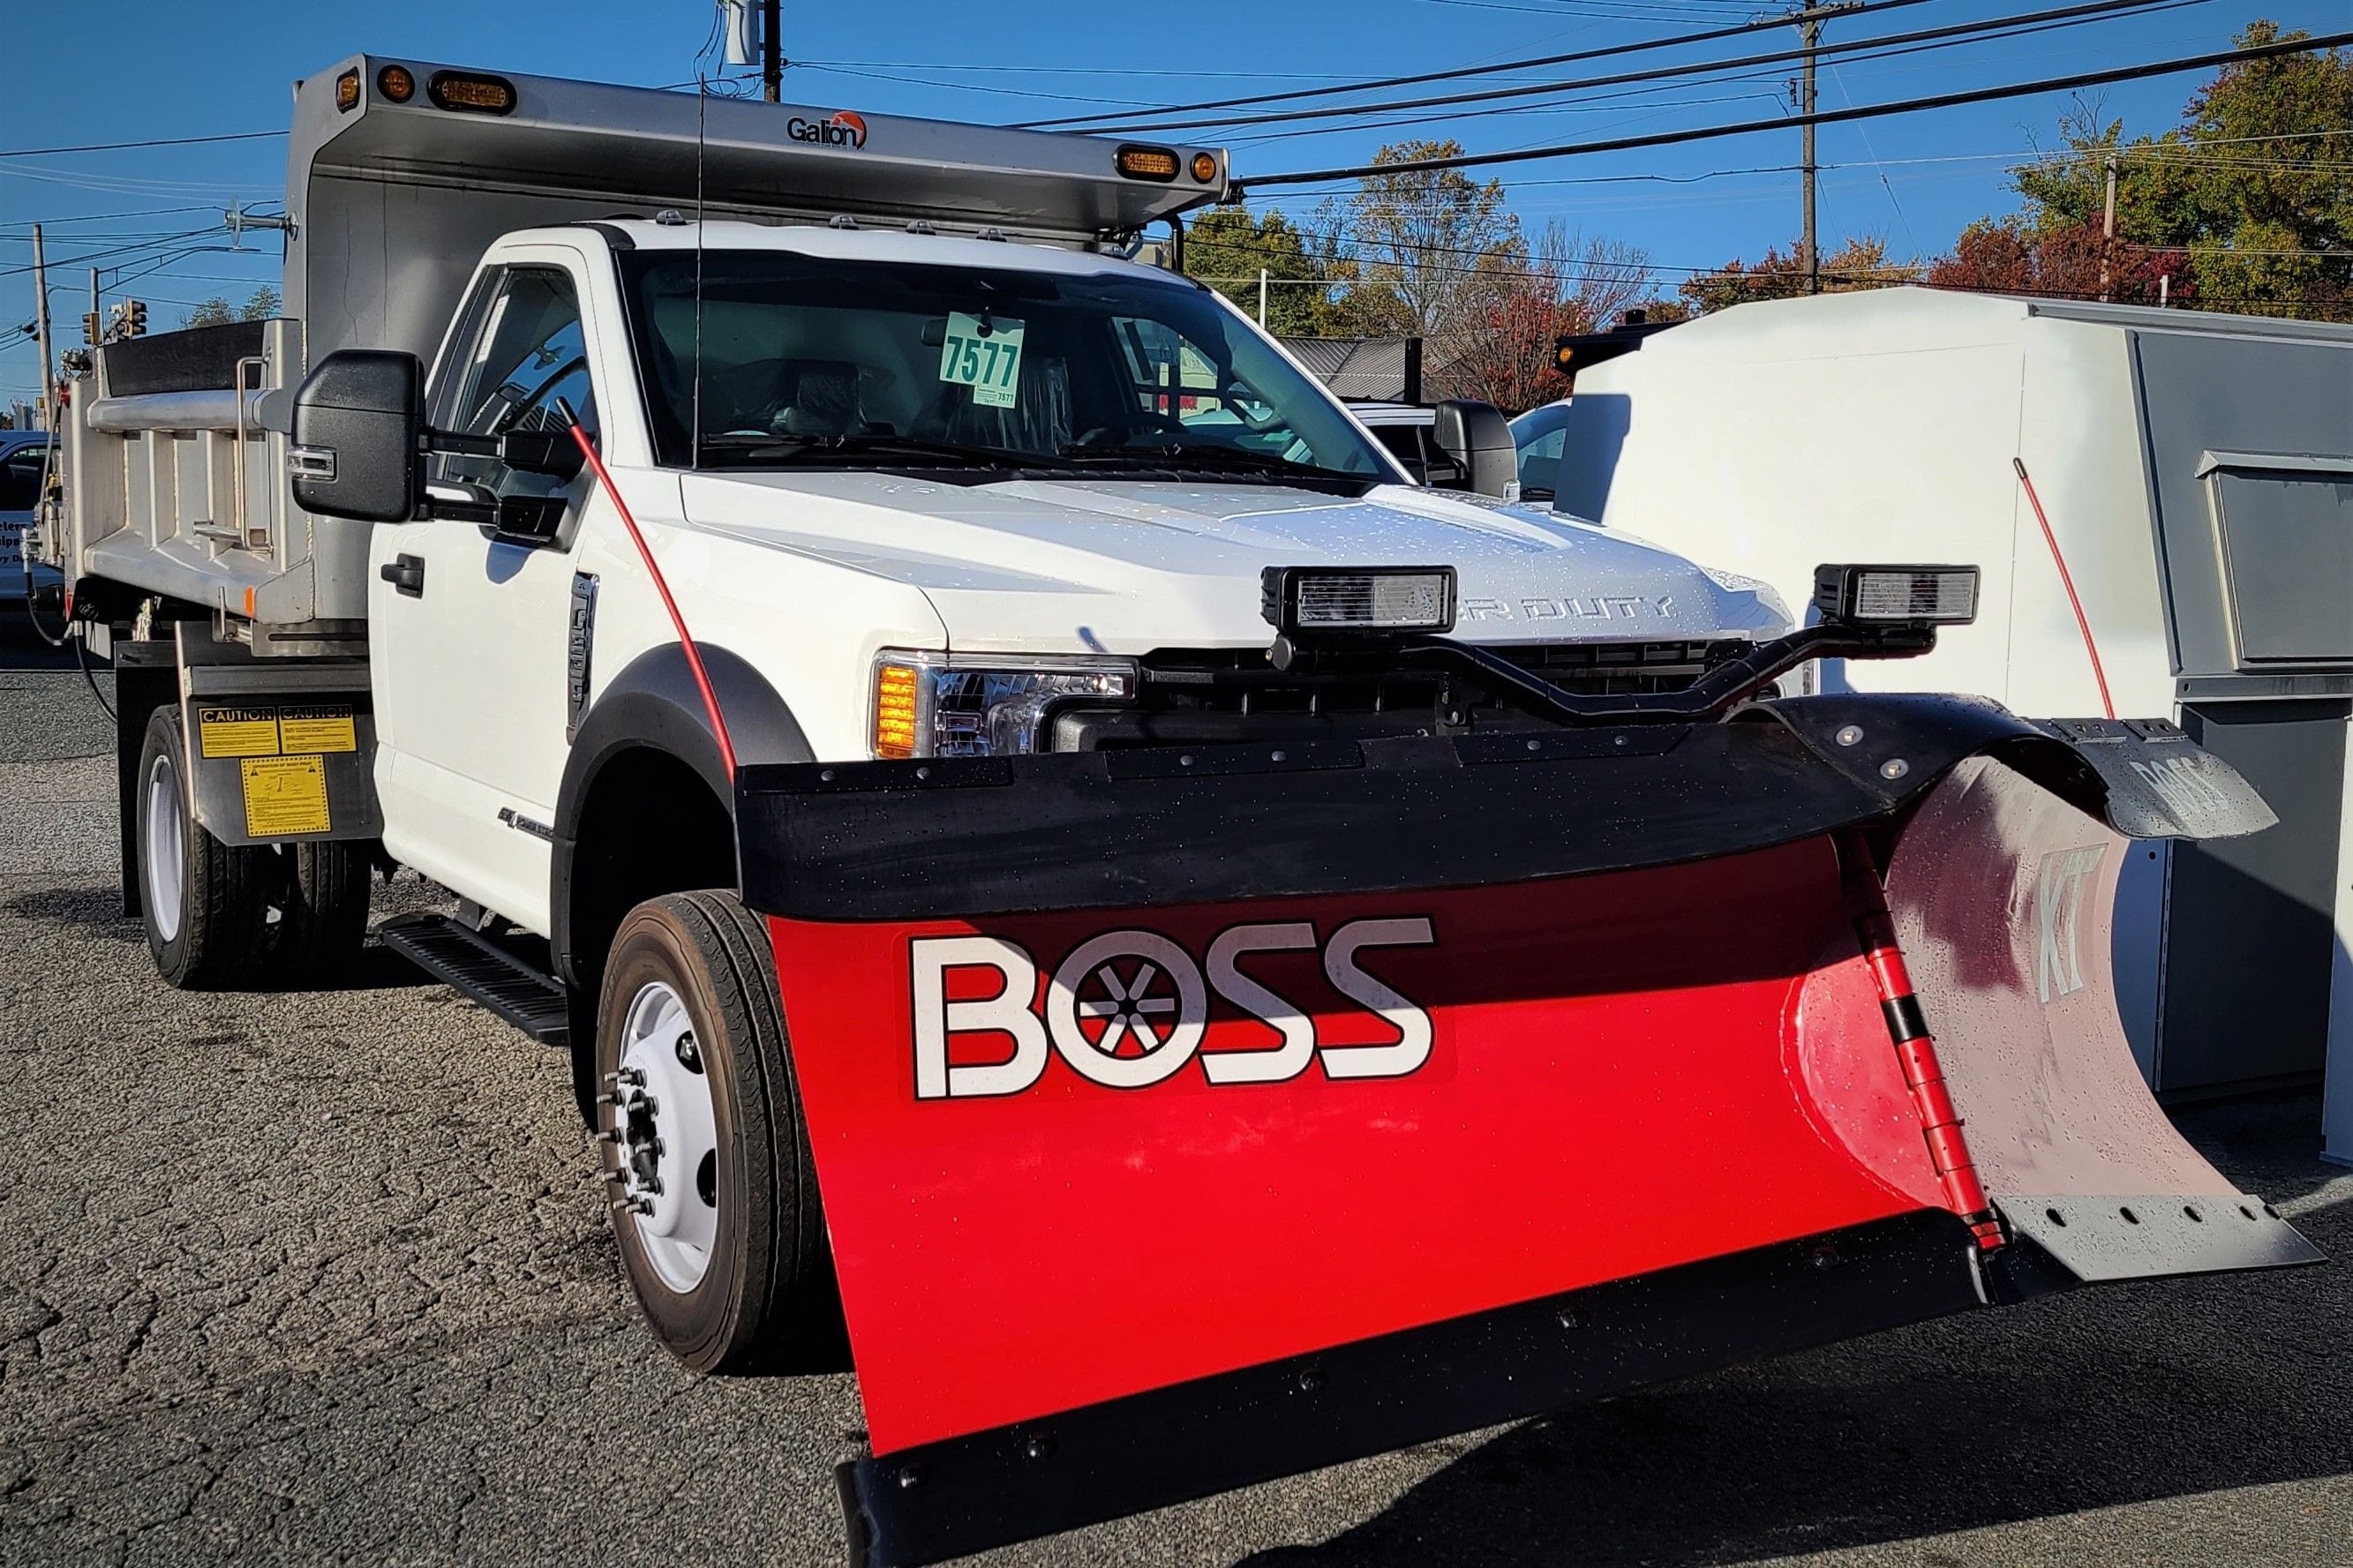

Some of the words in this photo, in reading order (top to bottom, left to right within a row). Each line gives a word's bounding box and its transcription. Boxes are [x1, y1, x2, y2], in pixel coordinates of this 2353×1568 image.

[786, 116, 858, 146] Galion
[945, 335, 1018, 387] 7577
[997, 392, 1014, 402] 7577
[1521, 596, 1673, 620] DUTY
[203, 709, 274, 723] CAUTION
[282, 706, 350, 720] CAUTION
[908, 917, 1438, 1100] BOSS
